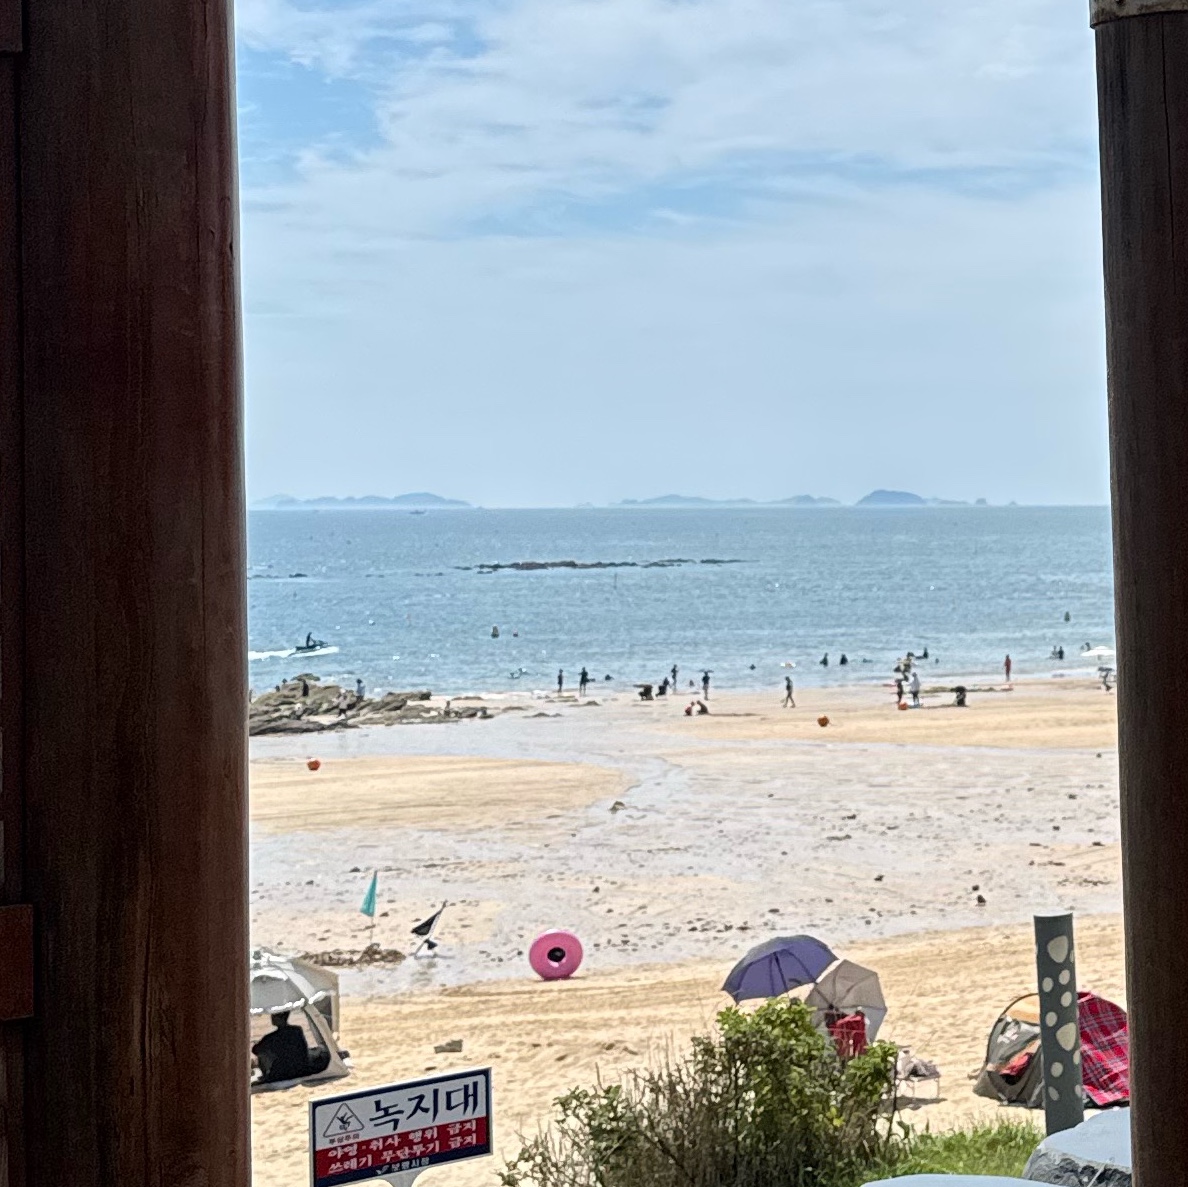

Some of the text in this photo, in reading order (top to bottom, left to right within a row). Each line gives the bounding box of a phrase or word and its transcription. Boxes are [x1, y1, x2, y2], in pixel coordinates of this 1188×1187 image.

[369, 1081, 479, 1131] 녹지대
[408, 1126, 438, 1142] 행위
[446, 1119, 477, 1135] 금지
[327, 1132, 477, 1174] 쓰레기 무단투기 금지
